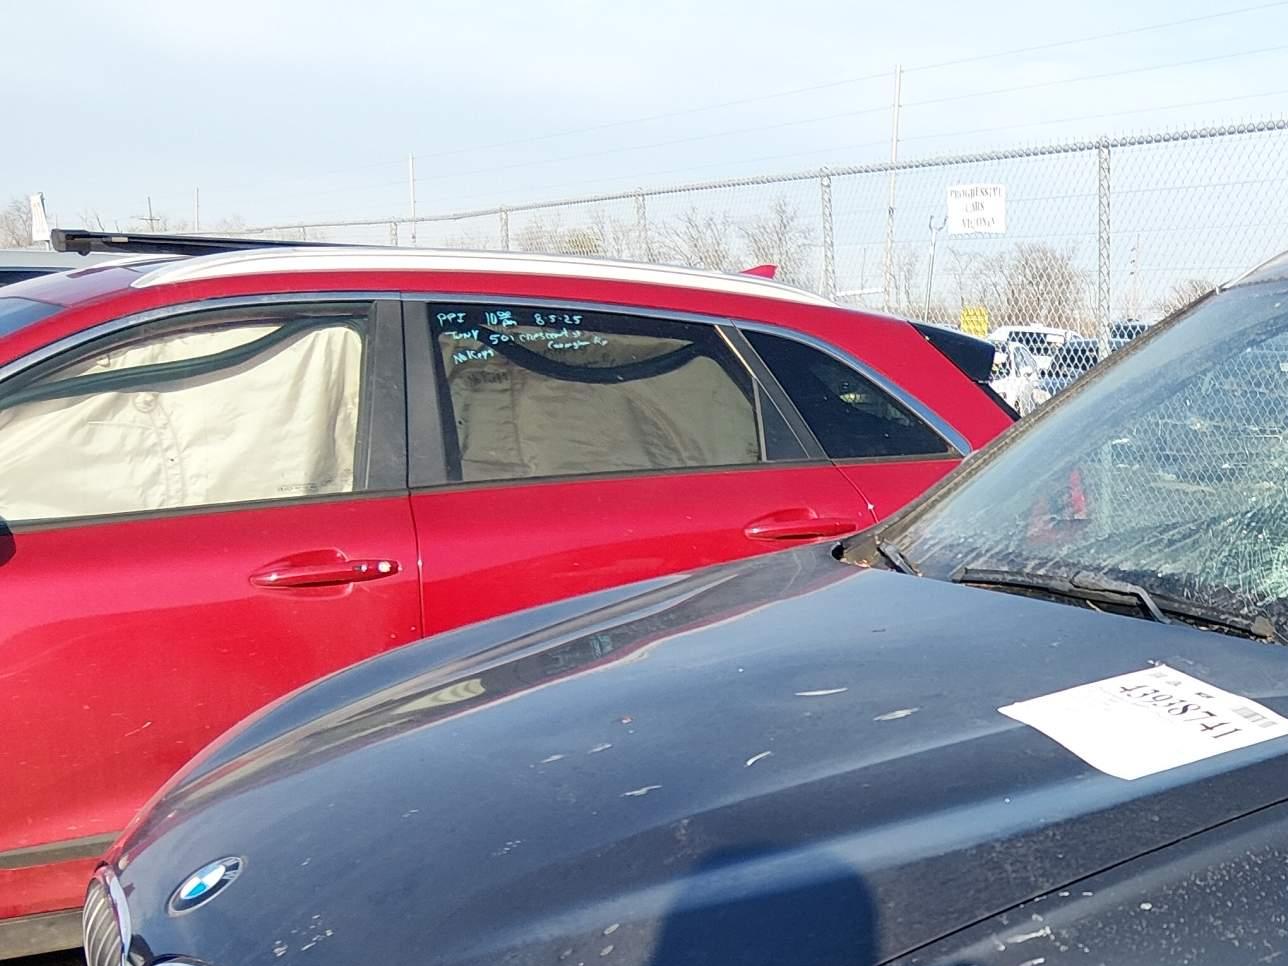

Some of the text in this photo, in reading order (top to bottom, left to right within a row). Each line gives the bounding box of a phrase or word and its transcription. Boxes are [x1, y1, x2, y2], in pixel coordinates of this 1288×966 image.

[950, 187, 1002, 199] PROGRESSIVE
[436, 312, 467, 327] PPI
[1119, 684, 1244, 739] 43938741
